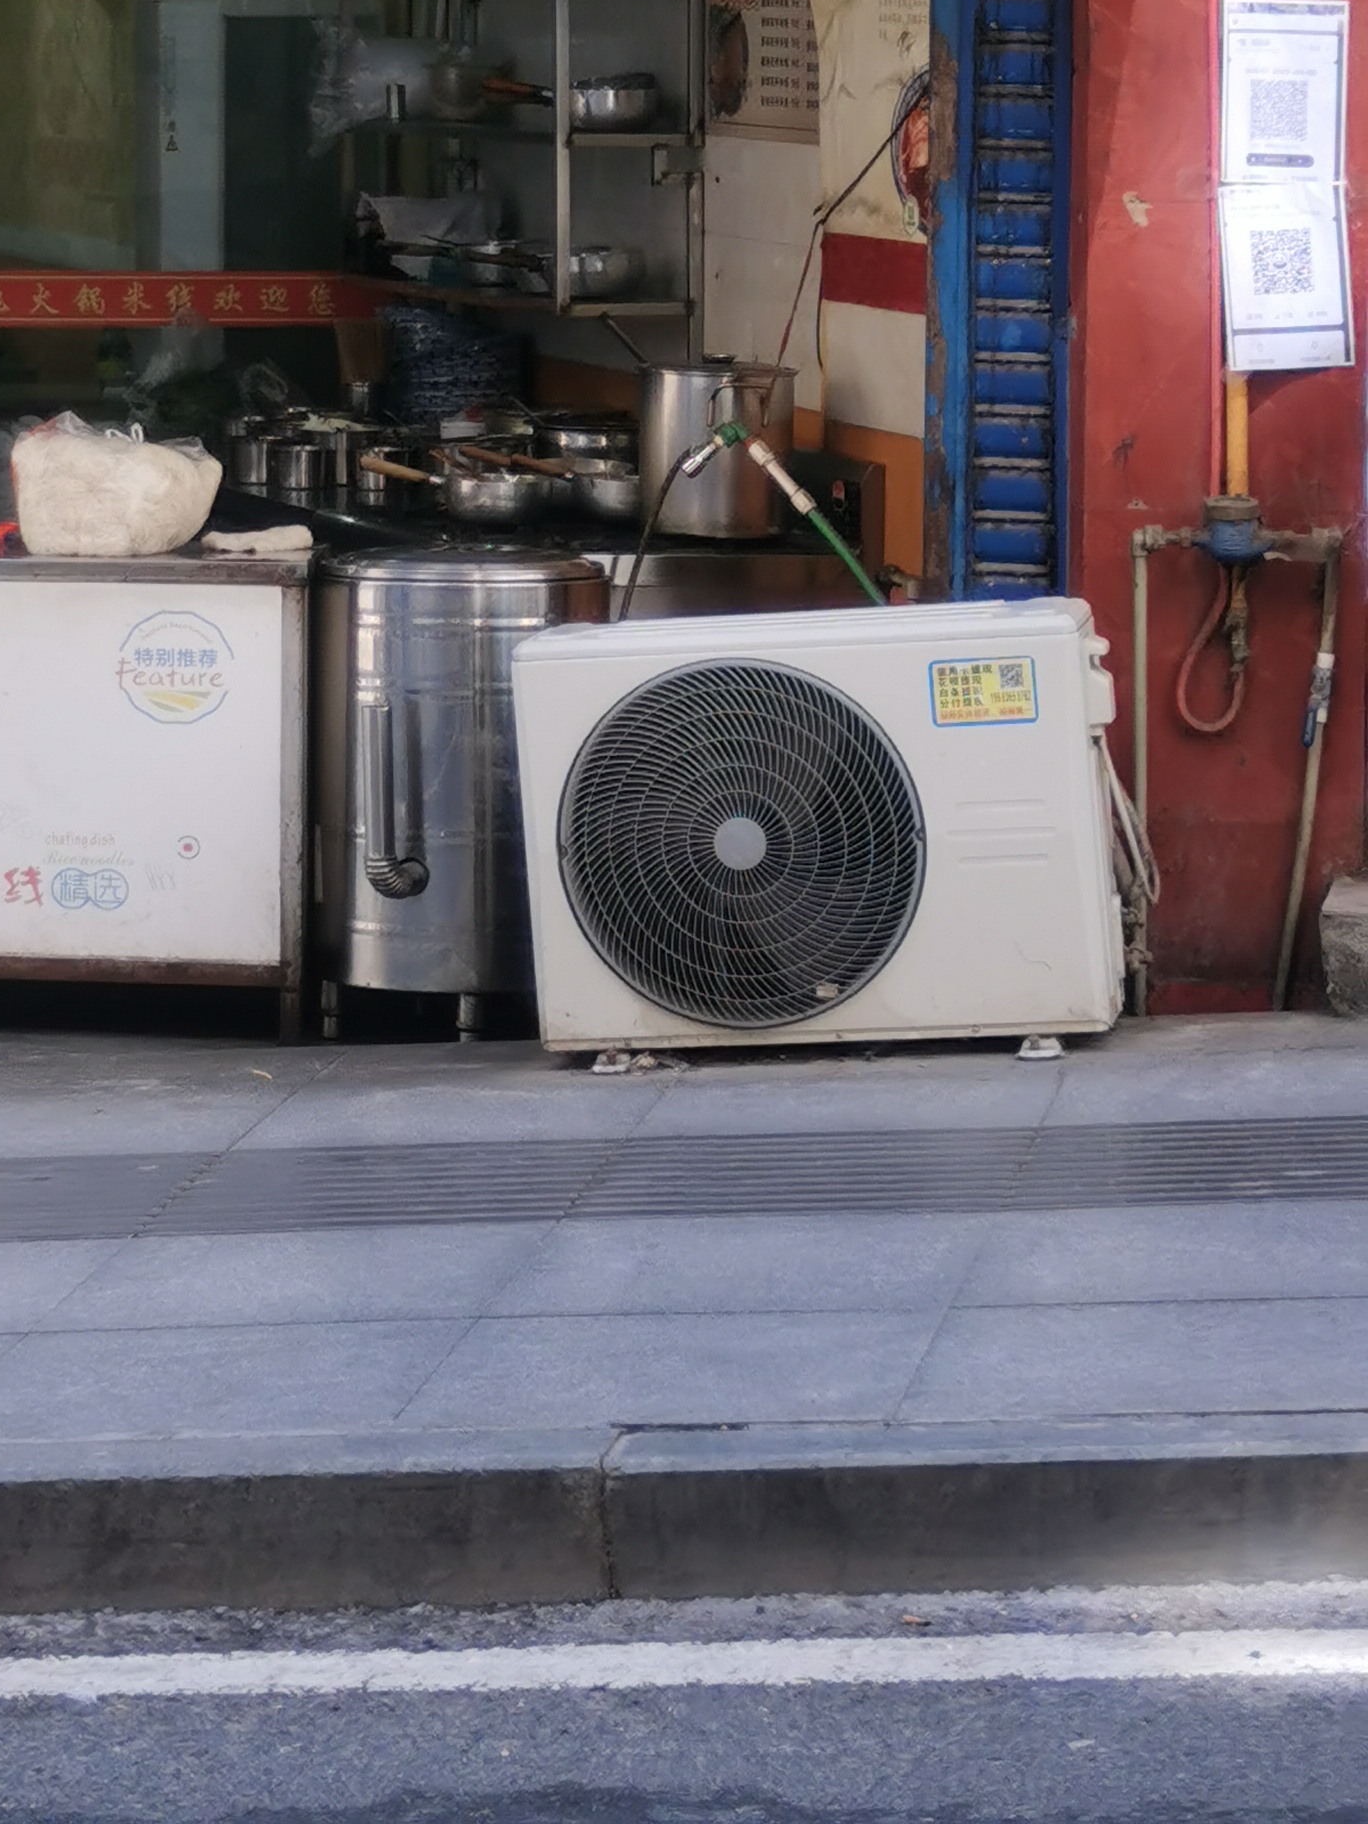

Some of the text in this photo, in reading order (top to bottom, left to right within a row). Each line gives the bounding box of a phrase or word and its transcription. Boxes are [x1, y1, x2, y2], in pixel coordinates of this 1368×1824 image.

[134, 648, 218, 667] 特别推荐
[115, 657, 225, 690] Feature
[59, 874, 122, 905] 精选
